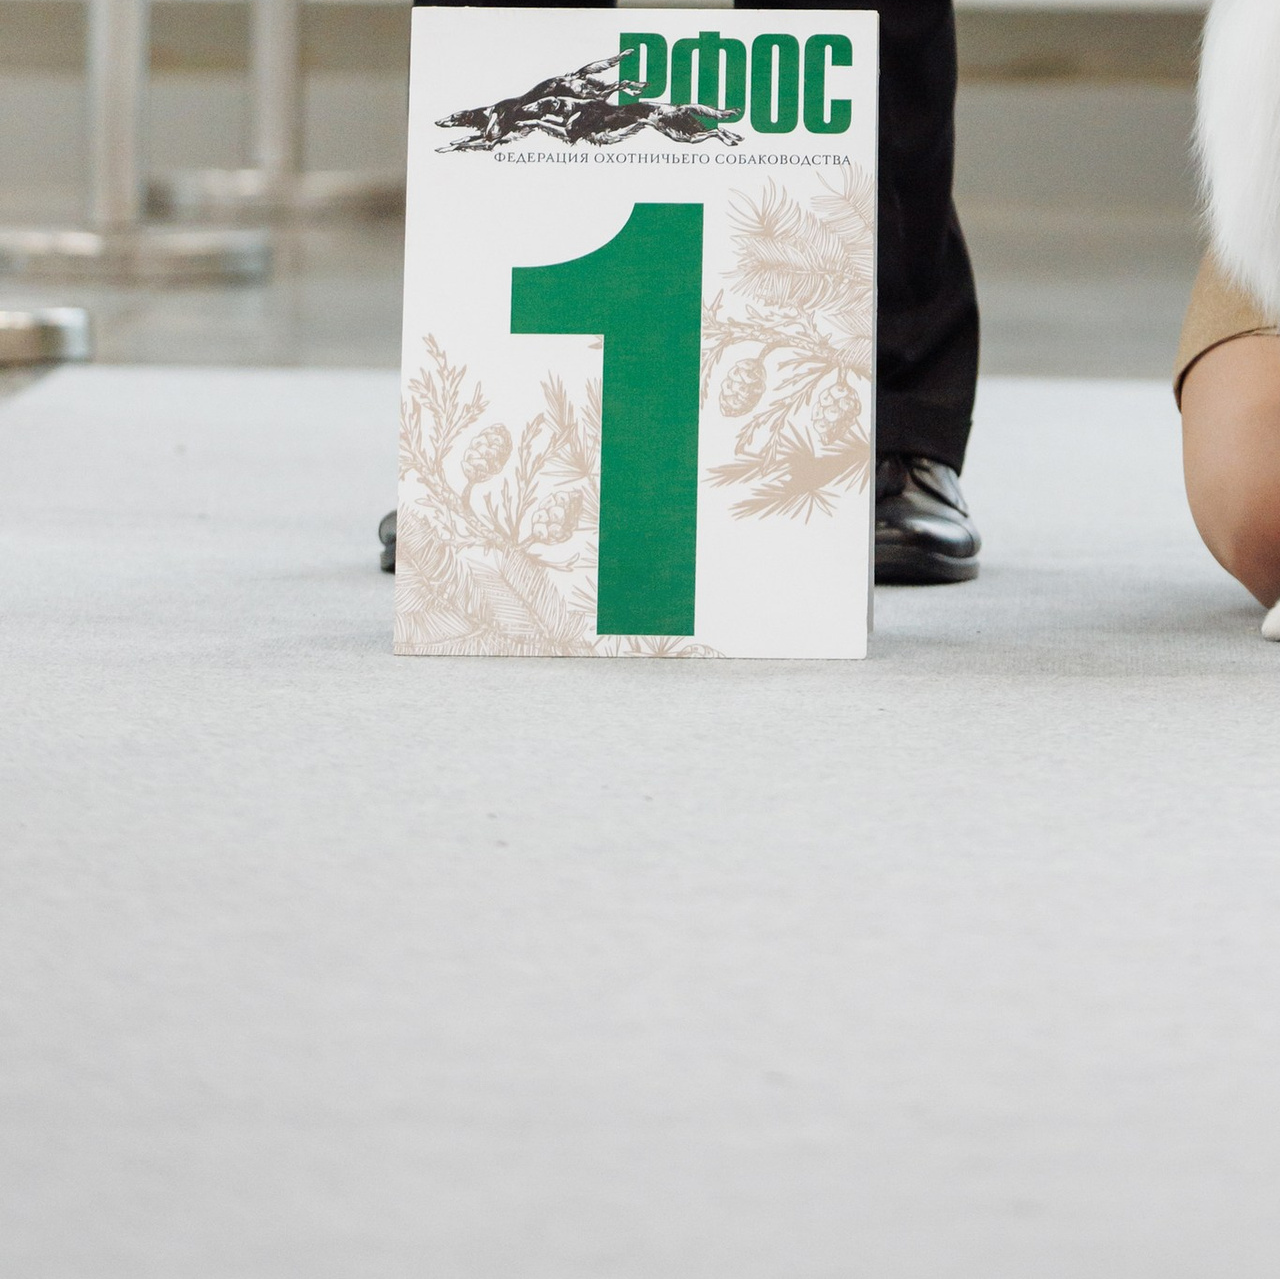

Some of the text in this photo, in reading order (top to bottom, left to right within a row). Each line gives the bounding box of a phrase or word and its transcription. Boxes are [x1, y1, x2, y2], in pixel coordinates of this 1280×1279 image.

[619, 31, 853, 135] РФОС
[493, 152, 851, 167] ФЕДЕРАЦИЯ ОХОТНИЧЬЕГО СОБАКОВОДСТВА
[510, 202, 704, 637] 1
